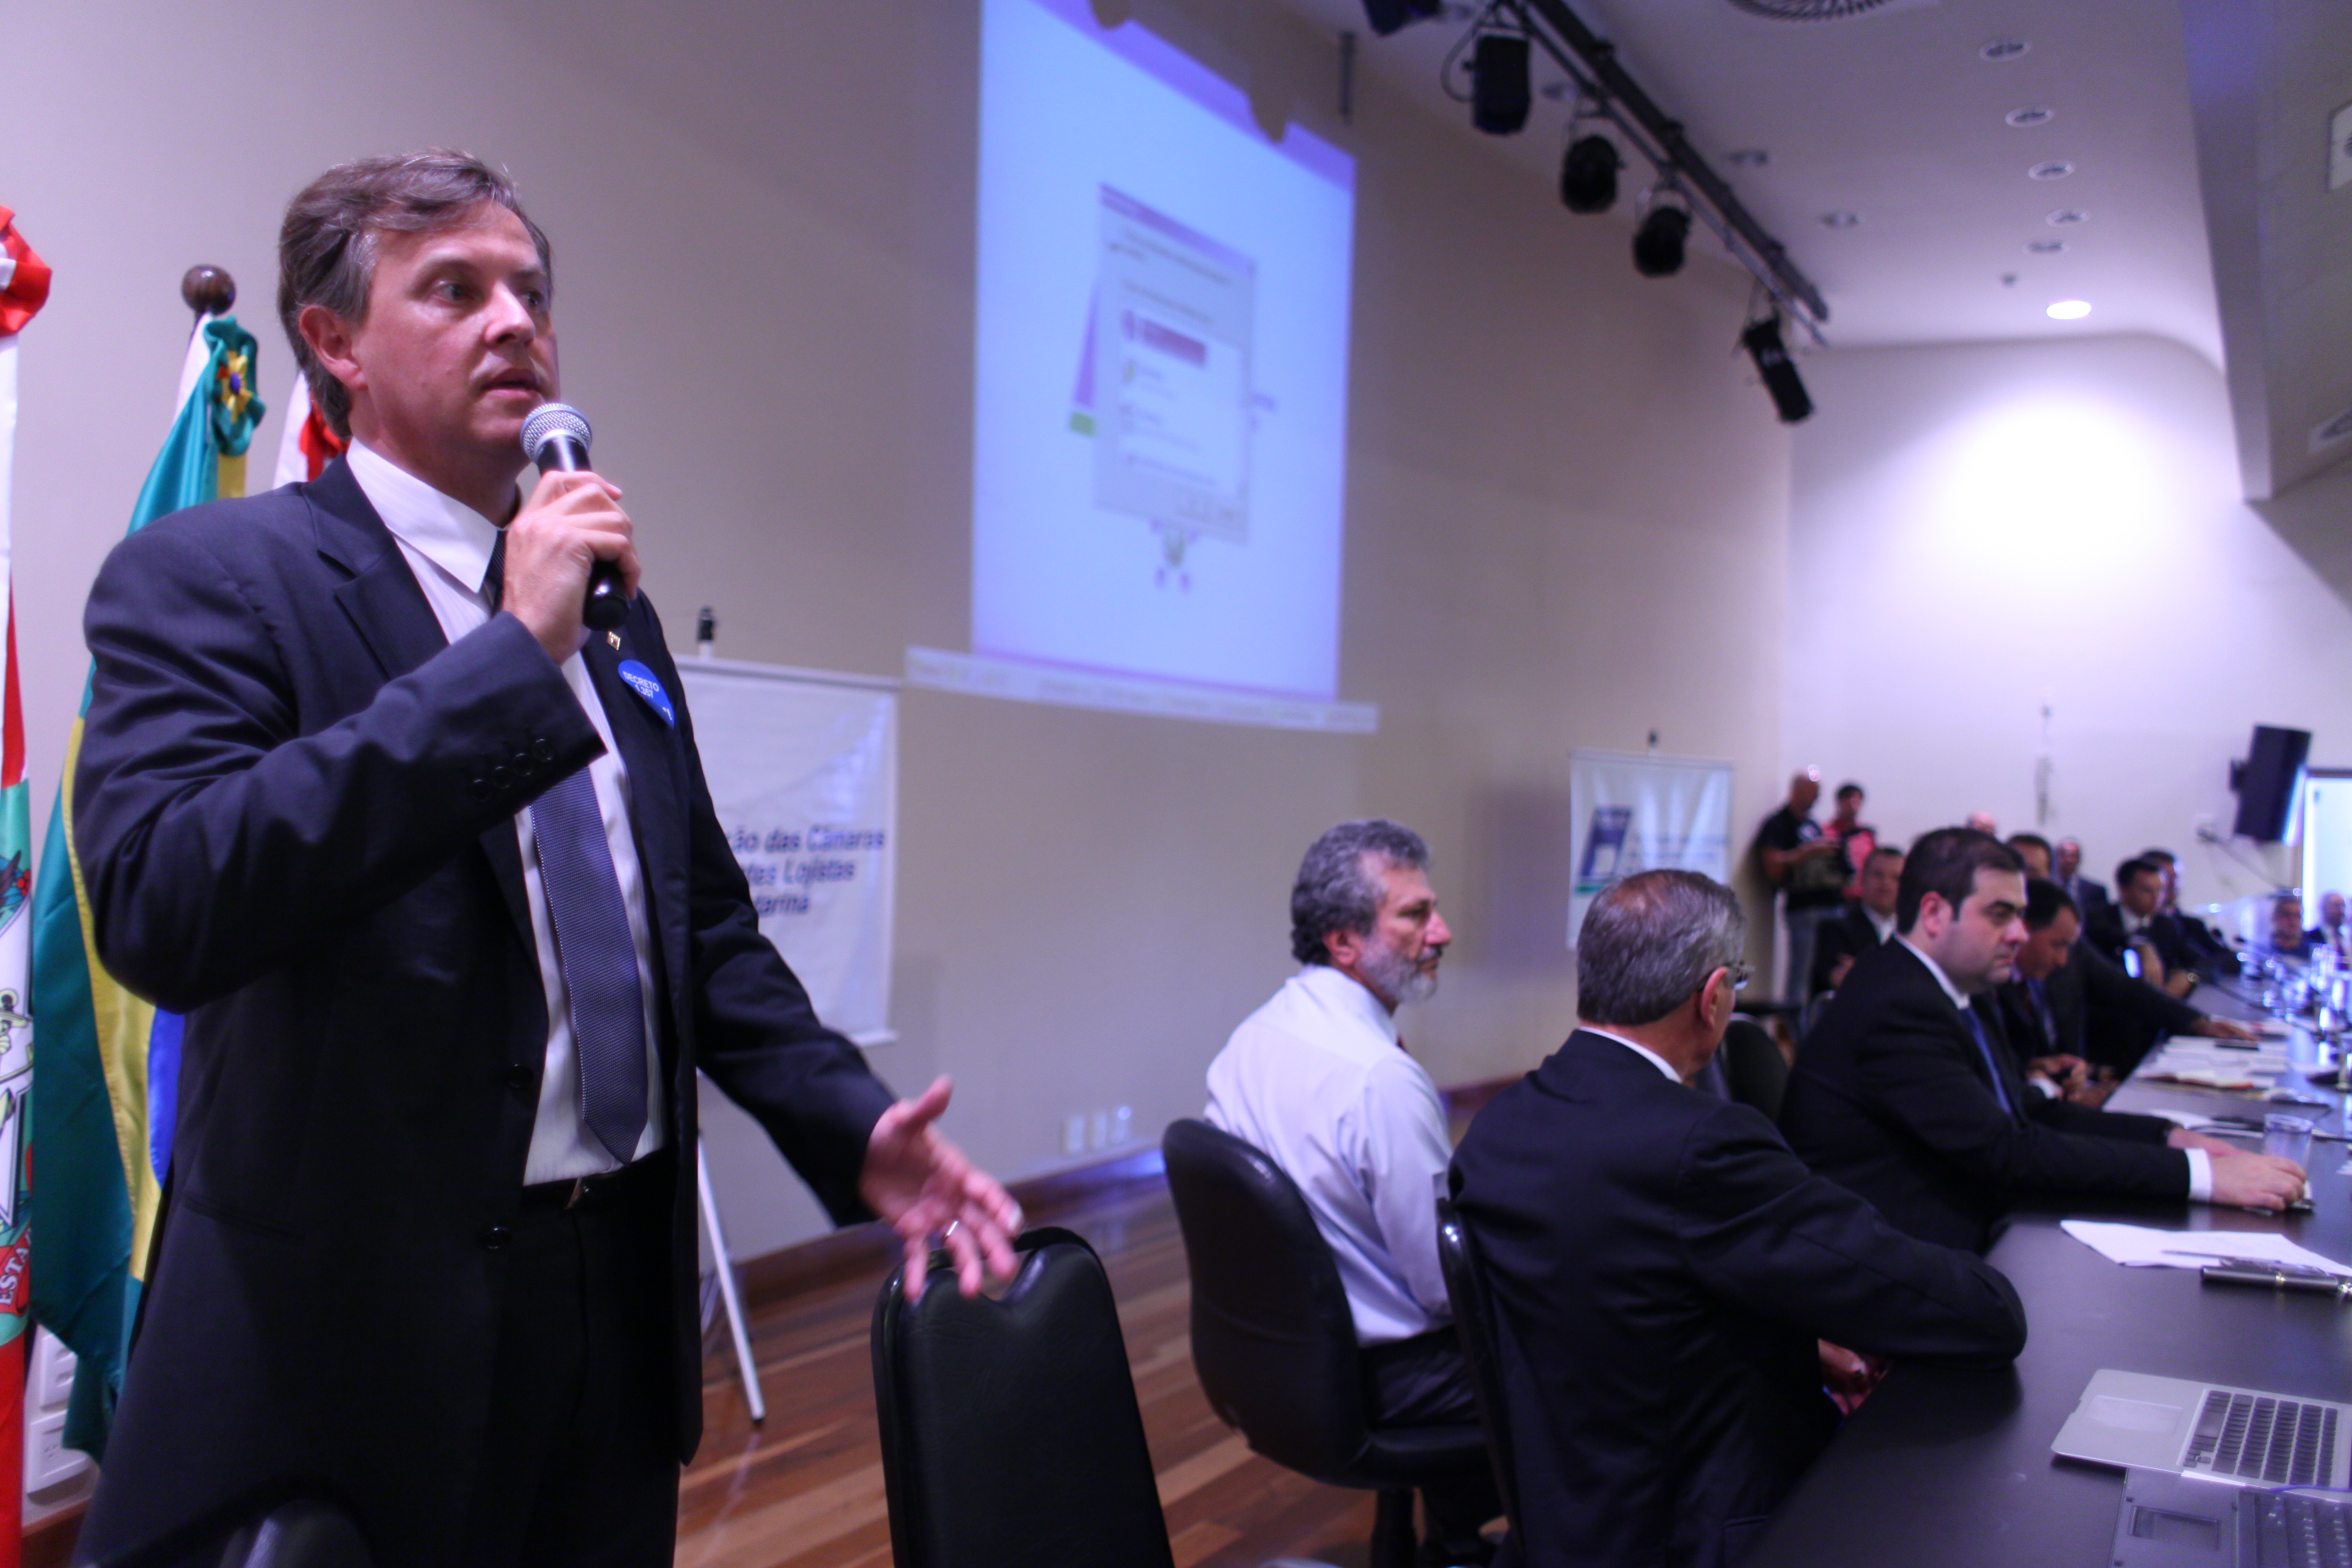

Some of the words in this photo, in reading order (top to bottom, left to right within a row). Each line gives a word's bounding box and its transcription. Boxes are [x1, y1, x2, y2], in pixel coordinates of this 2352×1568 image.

[622, 671, 659, 693] DECRETO
[765, 825, 800, 854] das
[783, 857, 855, 890] Lojistas
